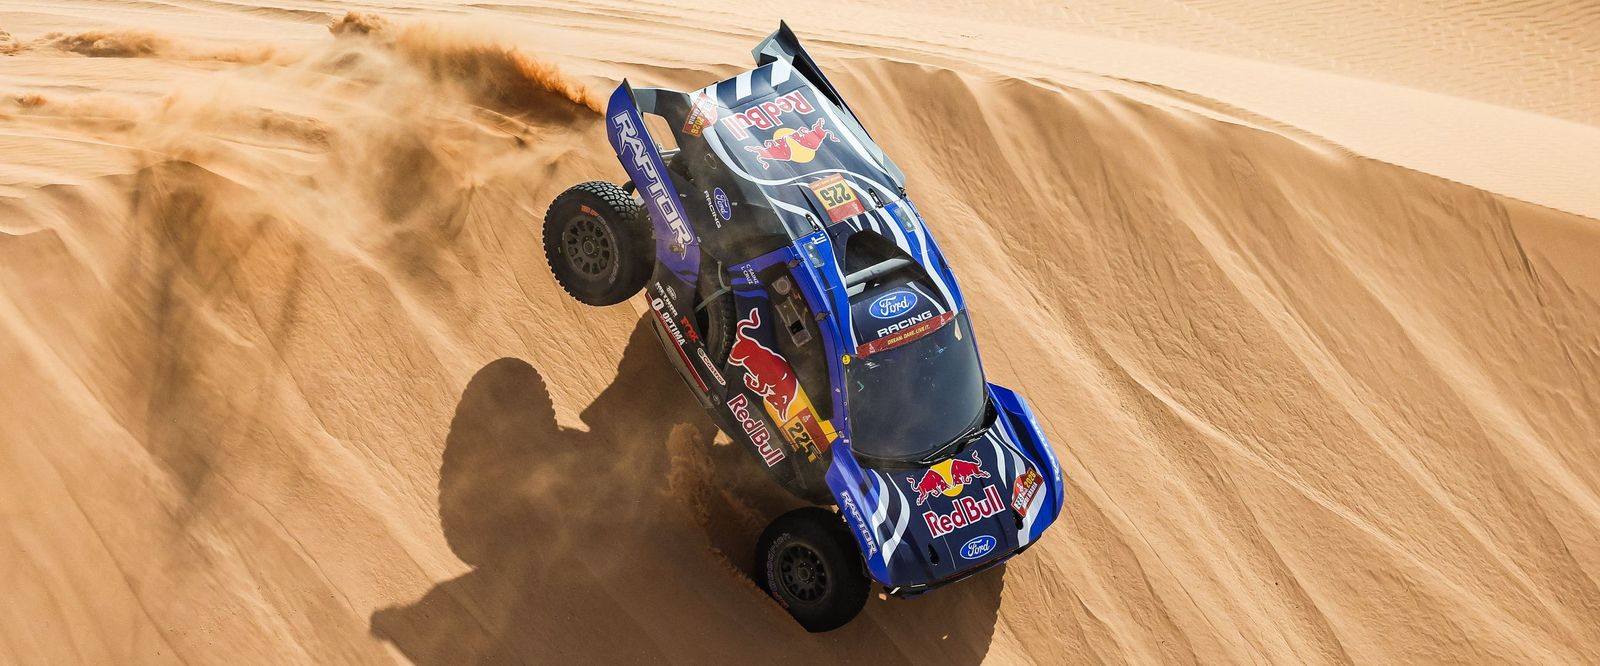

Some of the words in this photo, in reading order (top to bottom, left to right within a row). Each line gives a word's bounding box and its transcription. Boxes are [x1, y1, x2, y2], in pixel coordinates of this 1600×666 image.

[611, 111, 693, 260] RAPTOR
[819, 183, 851, 207] 225
[704, 190, 721, 229] RACING
[715, 194, 729, 215] Ford
[879, 295, 910, 316] Ford
[662, 312, 686, 346] OPTIMA
[877, 311, 933, 338] RACING
[703, 356, 725, 384] Castrol
[1024, 470, 1037, 488] 2026
[840, 490, 877, 560] RAPTOR
[967, 539, 990, 557] Ford
